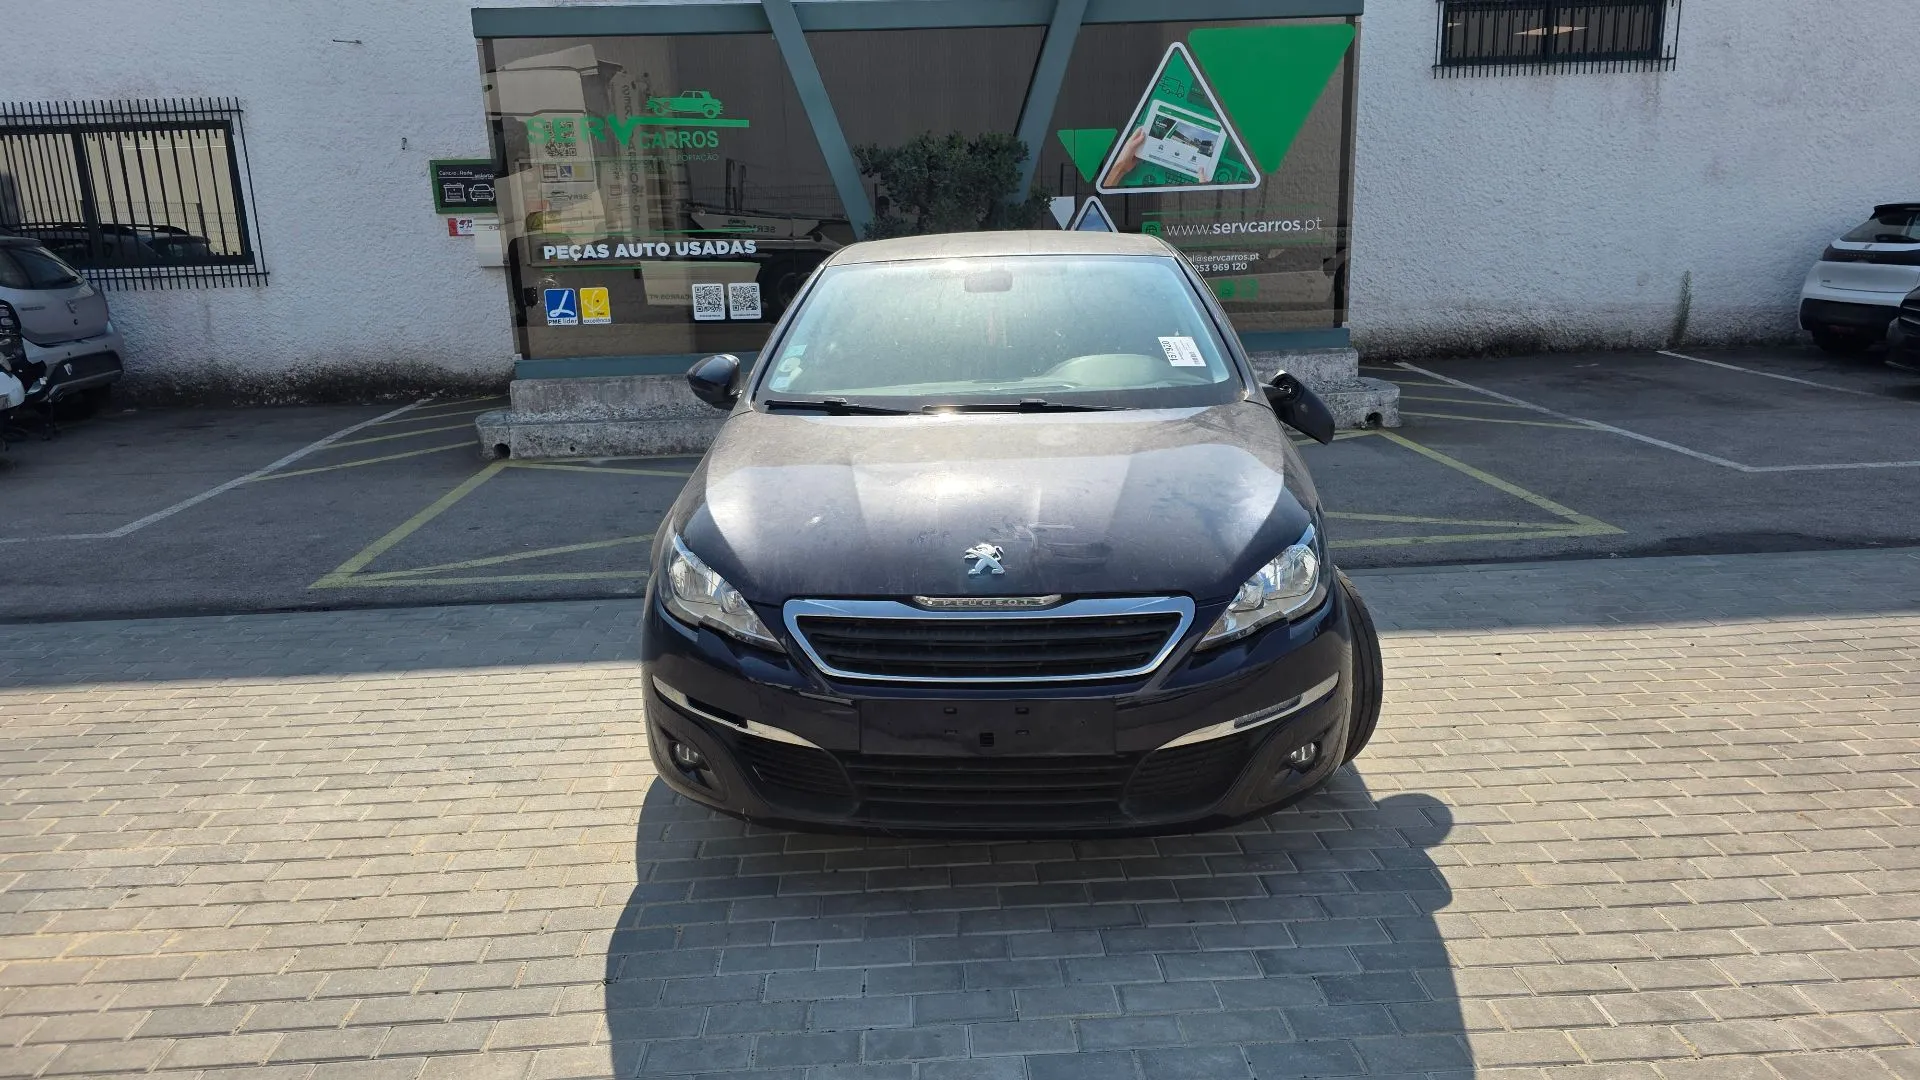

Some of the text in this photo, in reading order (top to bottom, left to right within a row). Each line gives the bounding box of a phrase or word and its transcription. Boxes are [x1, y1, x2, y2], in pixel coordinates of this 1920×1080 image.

[526, 113, 637, 146] SERV
[639, 130, 719, 149] CARROS
[1165, 216, 1324, 237] www.servcarros.pt
[543, 240, 757, 261] PEÇAS AUTO USADAS
[1187, 252, 1260, 263] al@servcarros.pt
[1212, 263, 1230, 271] 969
[1232, 262, 1248, 271] 120
[1162, 341, 1179, 361] 157920
